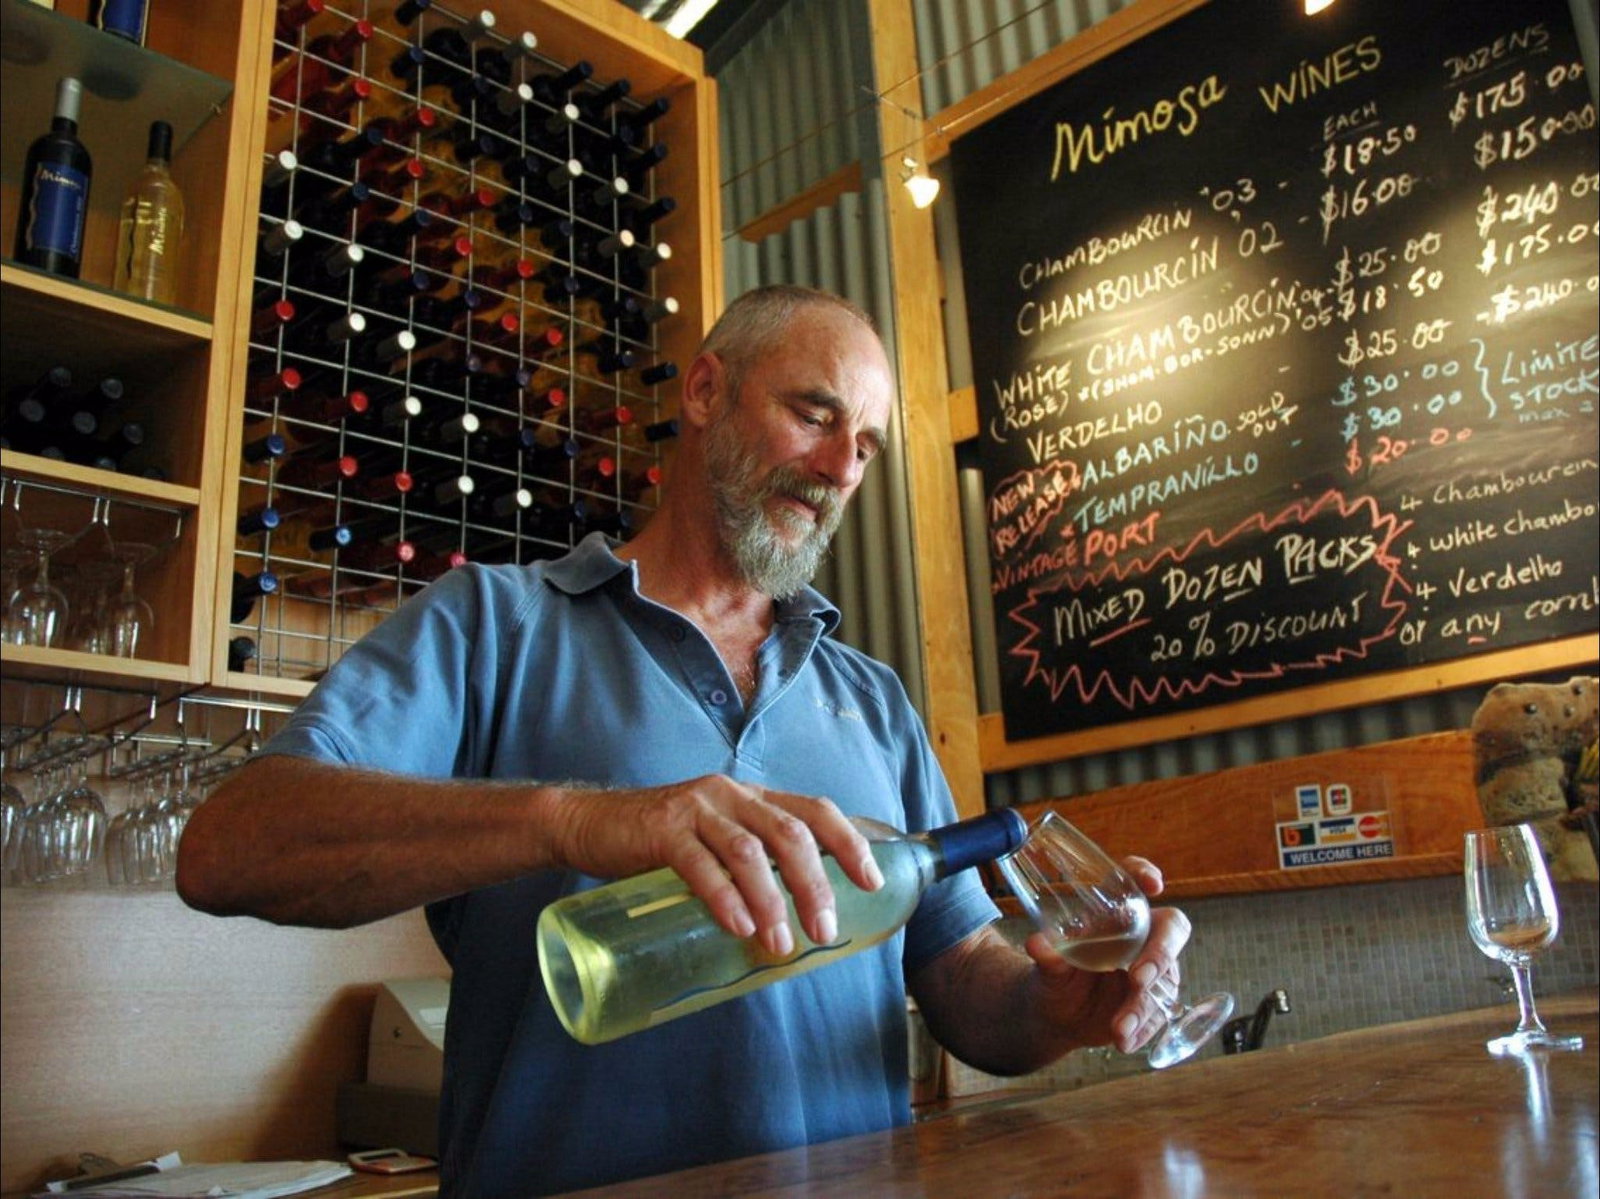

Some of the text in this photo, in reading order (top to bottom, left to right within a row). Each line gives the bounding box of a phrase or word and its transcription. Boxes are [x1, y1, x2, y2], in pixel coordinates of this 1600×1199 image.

[1051, 35, 1381, 181] Mimosa WINES
[1323, 23, 1550, 141] EACH DOZENS
[1017, 236, 1219, 336] CHAMBOURCIN
[1027, 401, 1163, 464] VERDELHO
[1236, 391, 1285, 431] SOLD
[1253, 404, 1299, 438] OUT
[992, 472, 1034, 521] NEW
[1074, 453, 1259, 533] TEMPRANILLO
[1400, 494, 1424, 512] 4
[1084, 511, 1161, 566] PORT
[1407, 541, 1422, 559] 4
[1054, 533, 1378, 646] MIXED DOZEN PACKS
[1416, 553, 1563, 600] 4 Verdelho
[1225, 591, 1368, 656] DISCOUNT
[1440, 610, 1501, 637] any
[1290, 843, 1392, 865] WELCOME HERE
